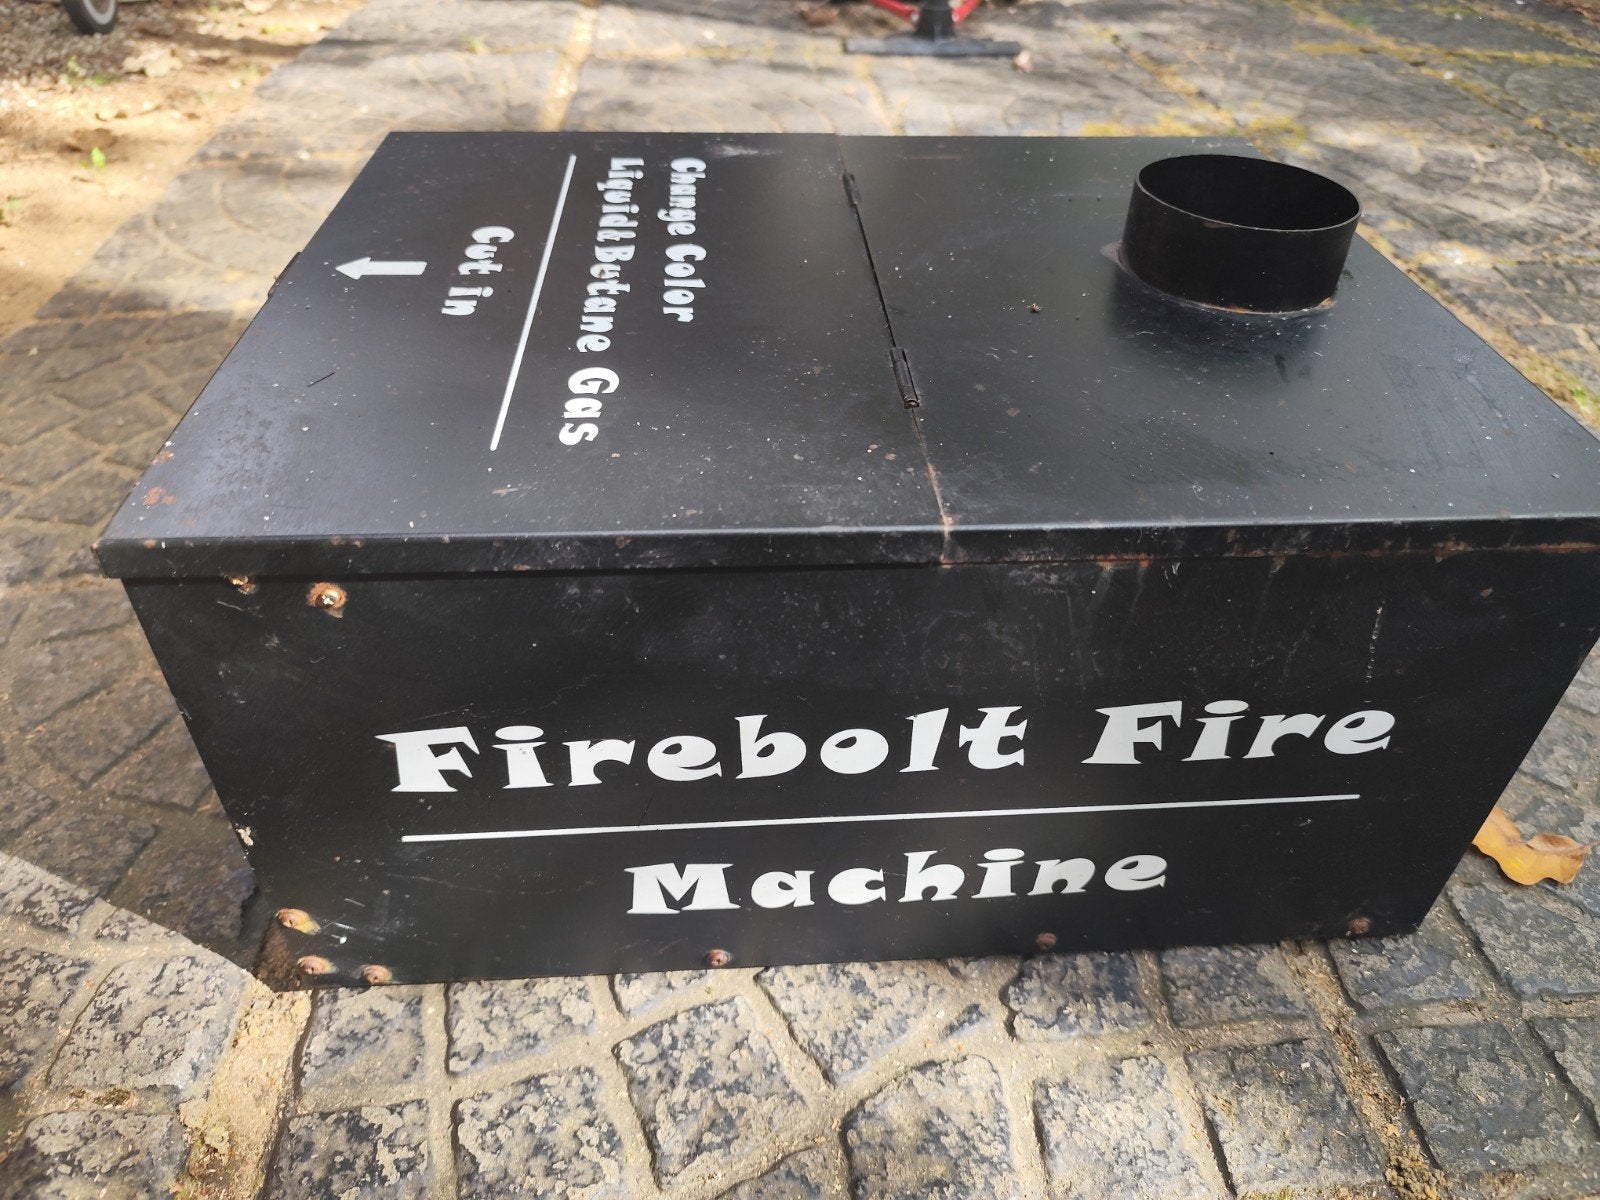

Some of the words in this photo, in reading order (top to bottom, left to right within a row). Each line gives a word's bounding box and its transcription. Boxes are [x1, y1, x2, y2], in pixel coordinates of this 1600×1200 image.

[657, 157, 707, 236] Change
[457, 225, 515, 276] Cut
[662, 243, 707, 323] Color
[440, 286, 495, 316] in
[558, 366, 620, 446] Gas
[375, 705, 1028, 793] Firebolt
[1081, 699, 1395, 765] Fire
[624, 847, 1167, 915] Machine
